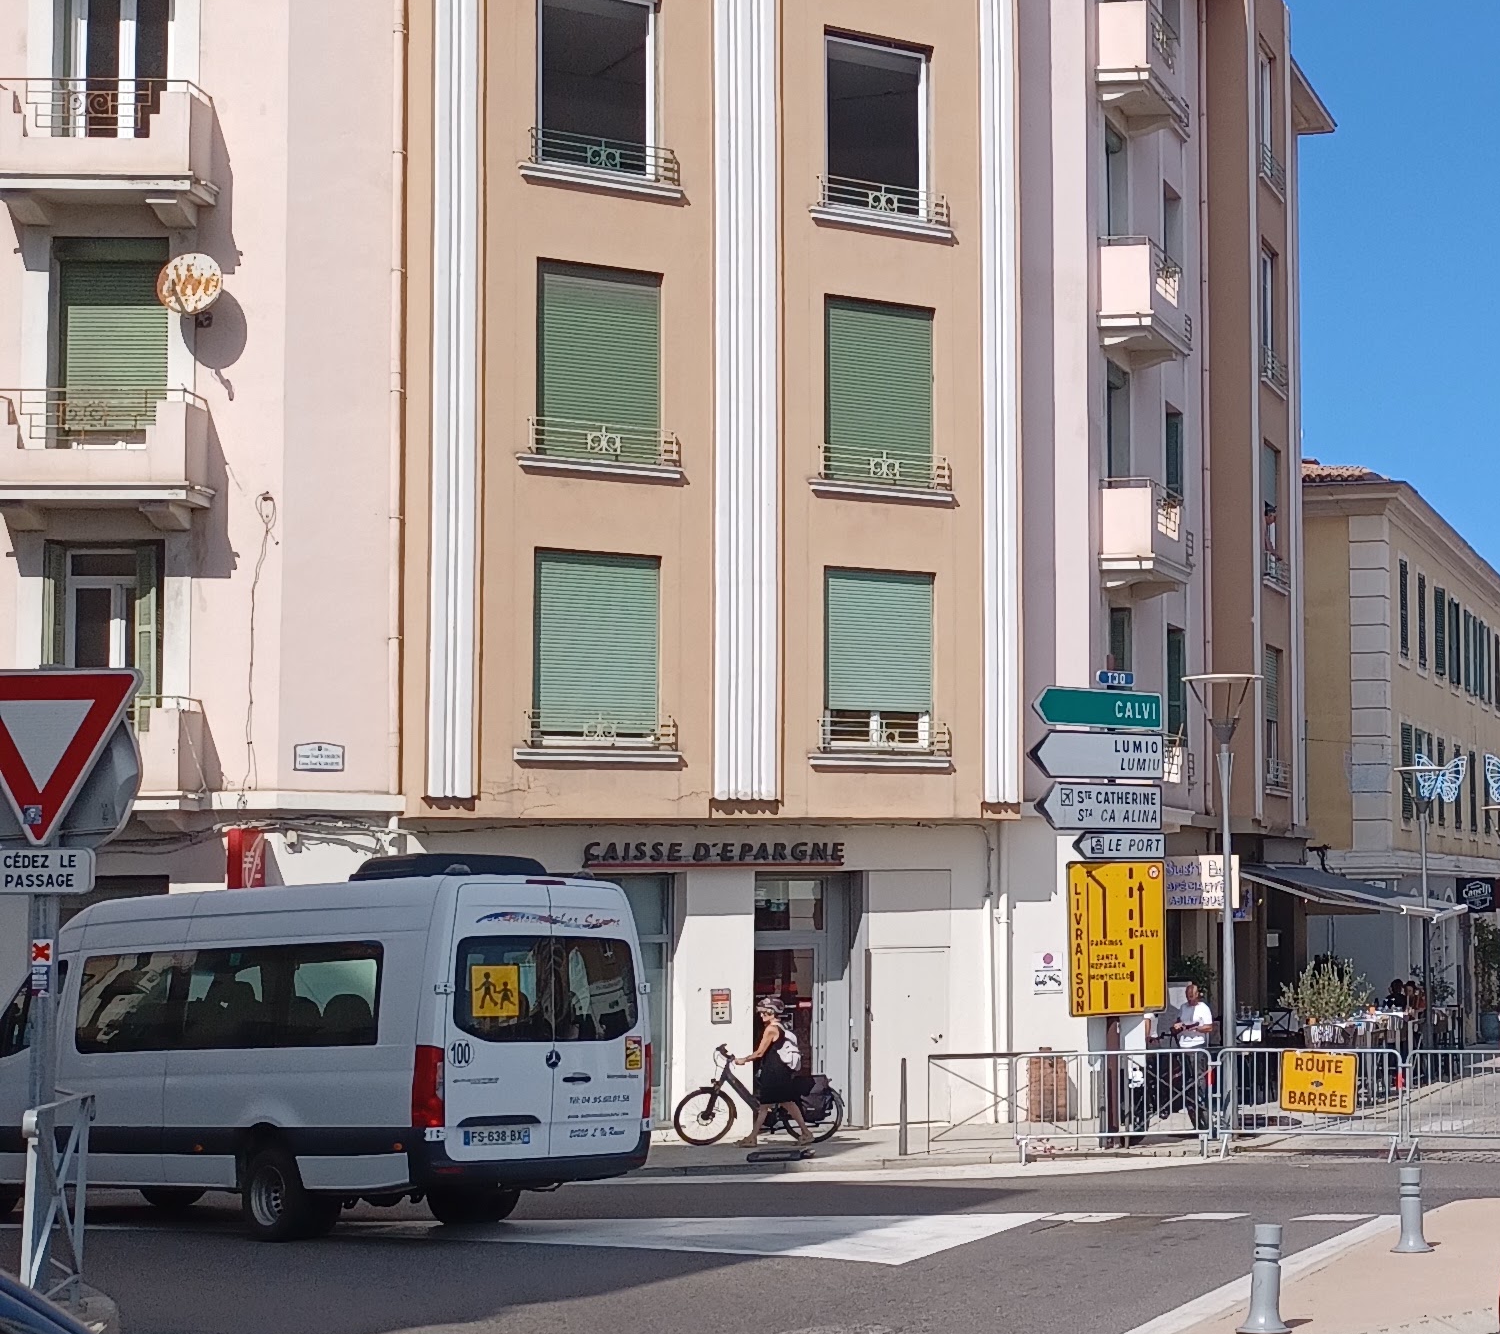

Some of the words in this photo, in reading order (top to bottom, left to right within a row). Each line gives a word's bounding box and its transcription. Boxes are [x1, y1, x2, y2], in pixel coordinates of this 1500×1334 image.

[1107, 673, 1126, 684] T30
[1115, 701, 1156, 719] CALVI
[1114, 740, 1158, 754] LUMIO
[1120, 758, 1160, 772] LUMIU
[1096, 791, 1156, 805] CATHERINE
[1100, 809, 1157, 823] CAALINA
[583, 841, 683, 862] CAISSE
[1108, 838, 1123, 852] LE
[1128, 838, 1162, 852] PORT
[4, 852, 50, 868] CÉDEZ
[60, 854, 77, 868] LE
[4, 873, 75, 888] PASSAGE
[1133, 929, 1159, 938] CALVI
[1073, 882, 1086, 1013] LIVRAISON
[1096, 953, 1119, 961] SANTA
[1090, 972, 1131, 981] MONTICELLO
[451, 1042, 471, 1065] 100
[1294, 1056, 1344, 1074] ROUTE
[1288, 1090, 1348, 1109] BARRÉE
[471, 1130, 522, 1143] FS-638-BX
